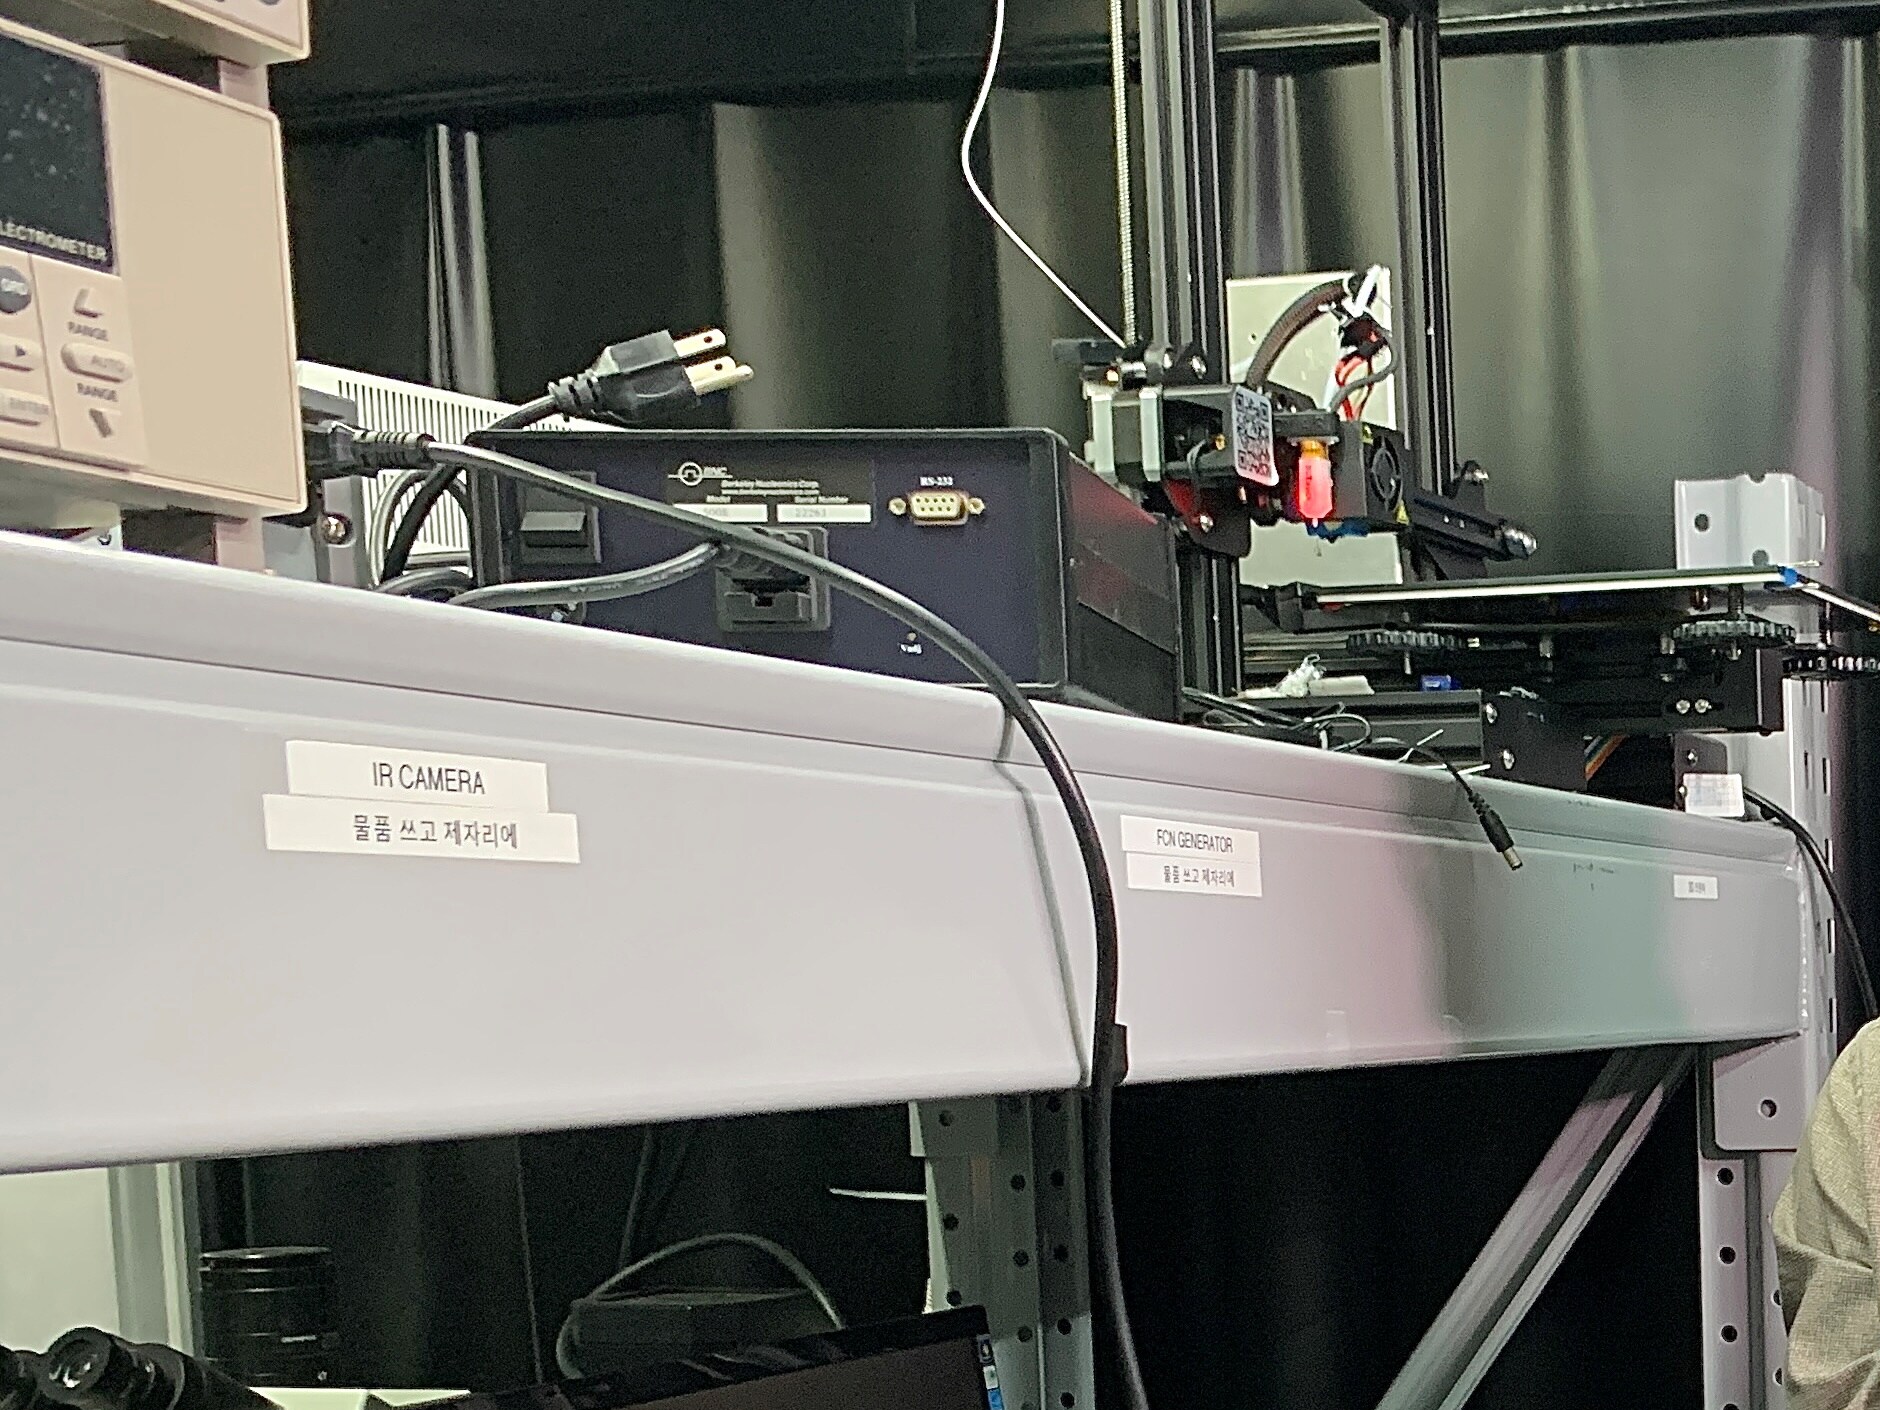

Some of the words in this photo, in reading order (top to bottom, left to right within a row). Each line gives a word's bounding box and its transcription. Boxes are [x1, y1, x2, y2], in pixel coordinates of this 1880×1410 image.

[0, 219, 108, 262] LECTROMETER
[67, 321, 109, 342] RANGE
[77, 383, 119, 402] RANGE
[920, 476, 954, 487] RS-232
[372, 761, 394, 788] IR
[399, 764, 486, 796] CAMERA
[353, 813, 392, 844] 물품
[399, 819, 438, 843] 쓰고
[444, 819, 519, 850] 제자리에
[1156, 828, 1176, 848] FCN
[1178, 831, 1233, 854] GENERATOR
[1163, 864, 1180, 884] 물품
[1183, 868, 1199, 883] 쓰고
[1201, 867, 1236, 889] 제자리에
